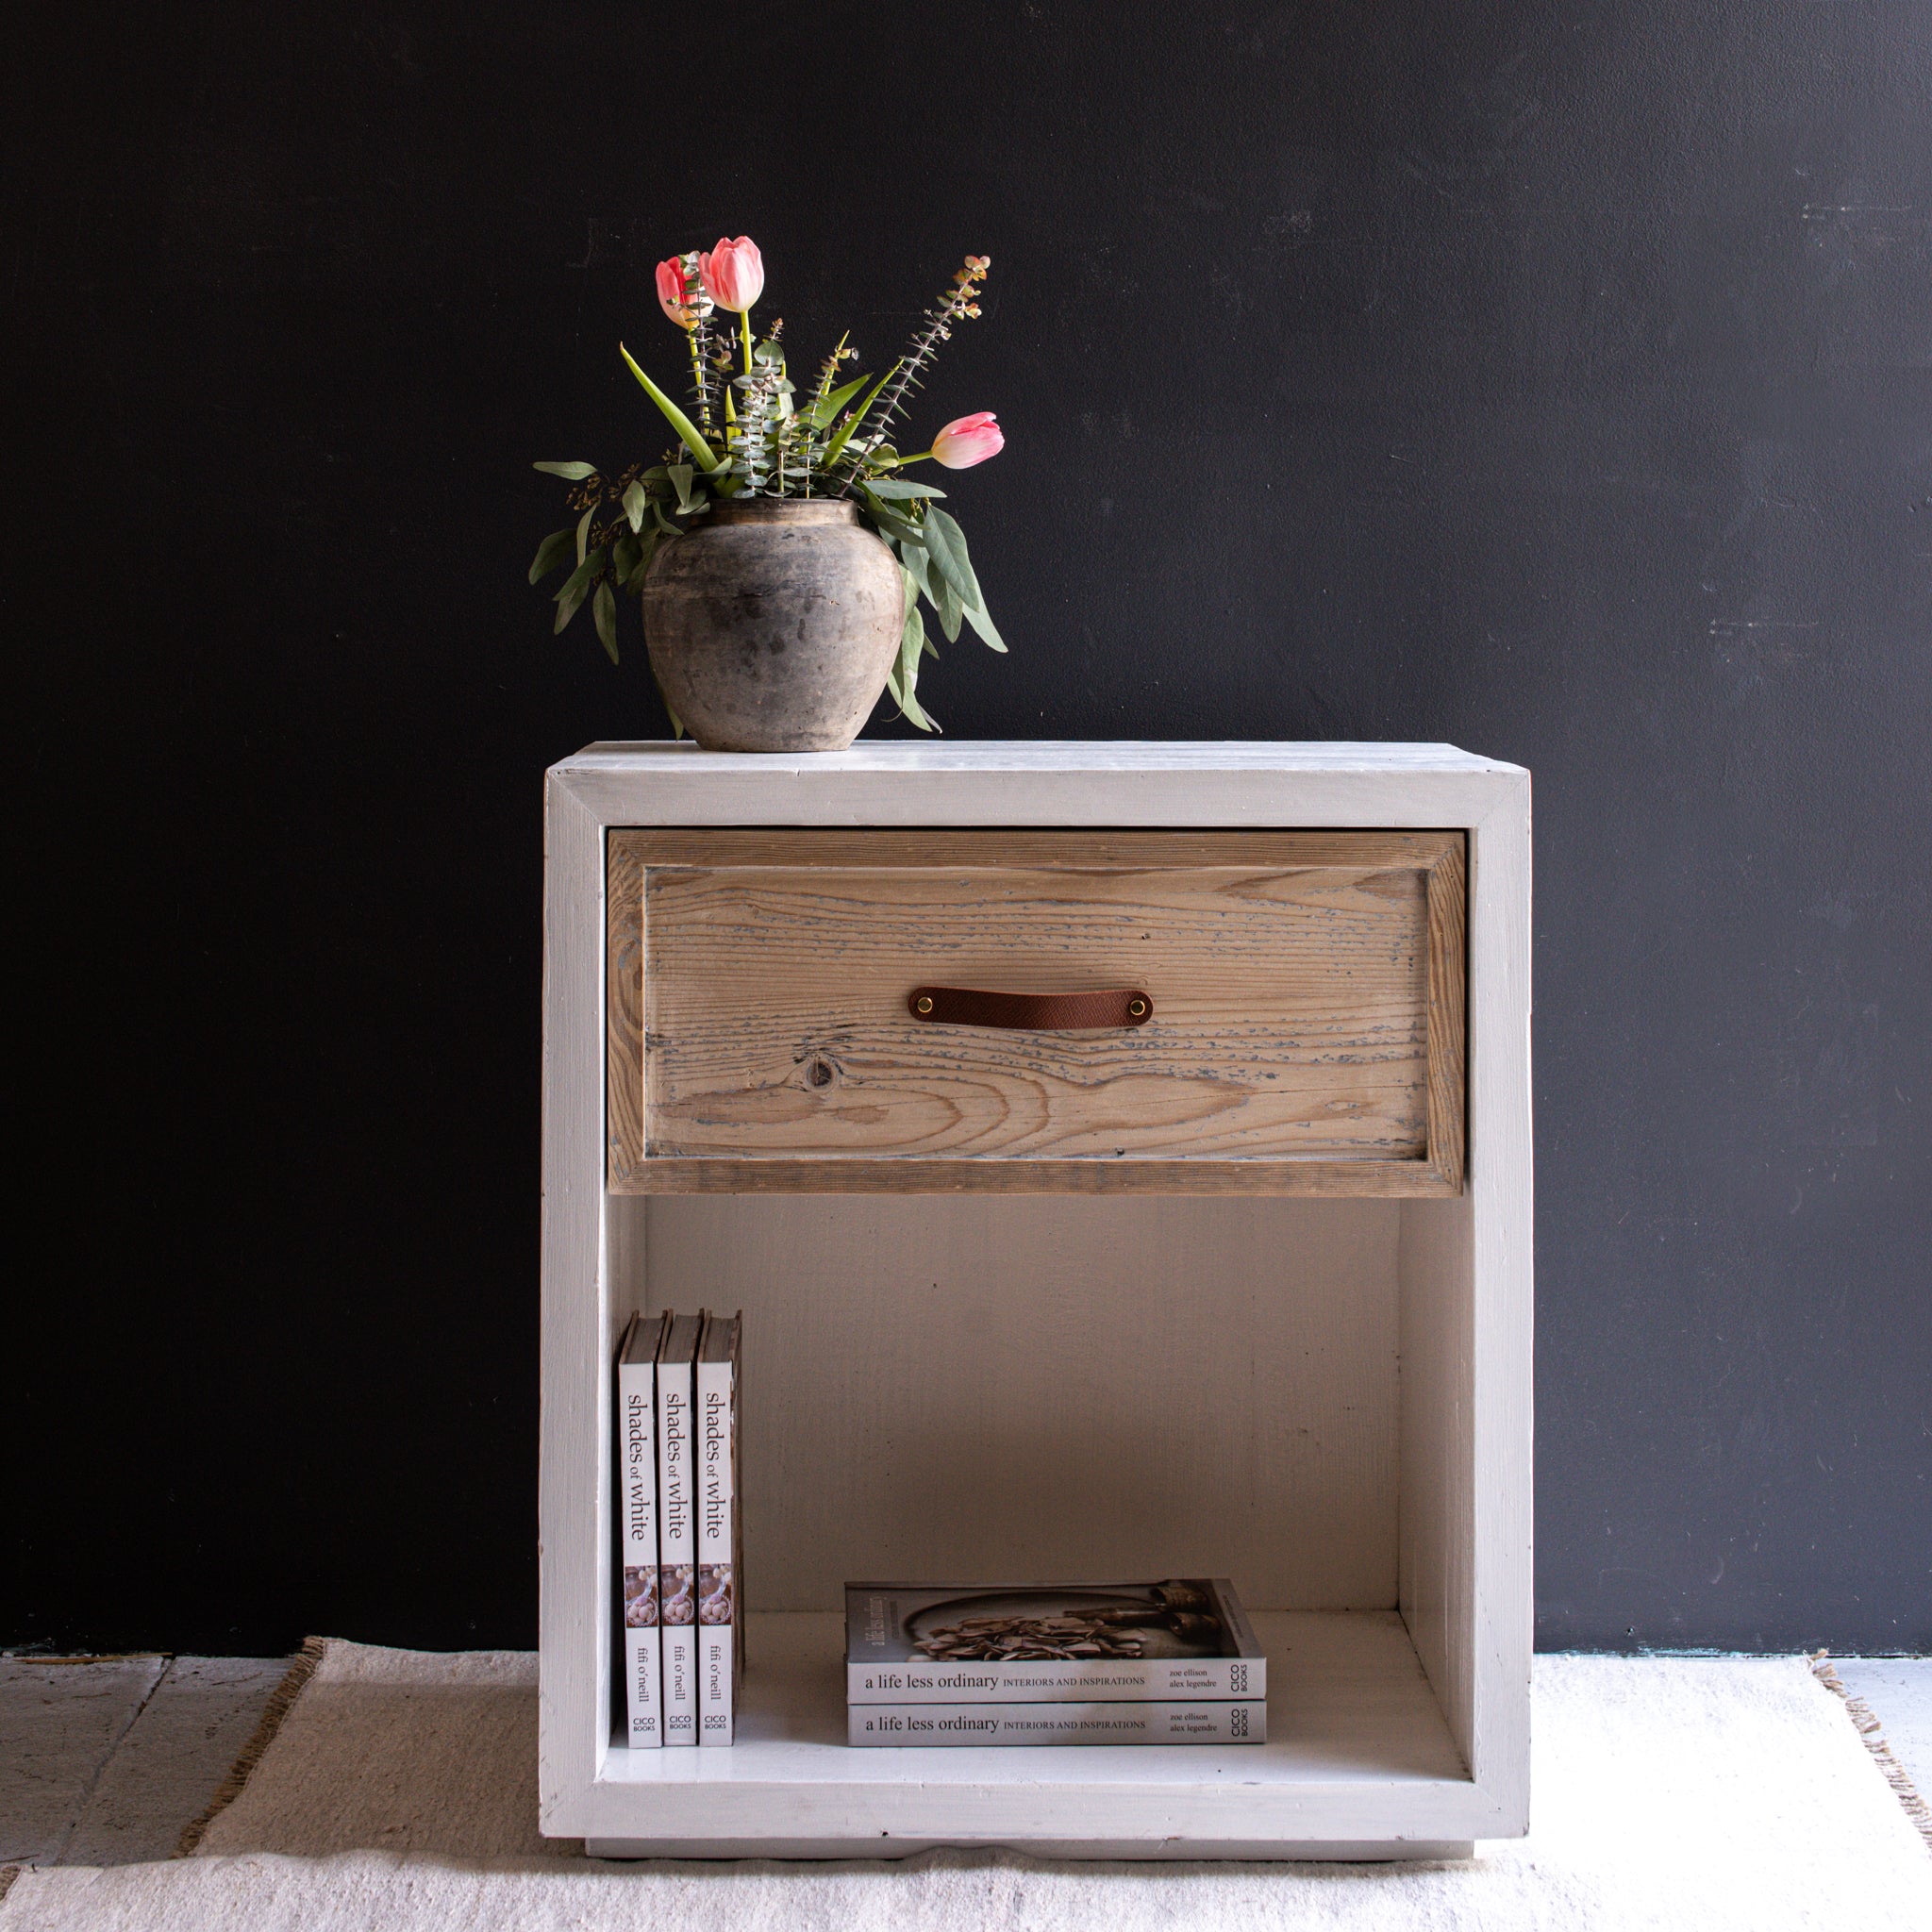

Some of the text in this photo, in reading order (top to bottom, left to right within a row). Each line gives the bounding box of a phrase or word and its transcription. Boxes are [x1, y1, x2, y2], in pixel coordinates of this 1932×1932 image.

[628, 1395, 650, 1541] shades of white
[667, 1393, 688, 1539] shades of white
[707, 1392, 726, 1539] shades of white
[638, 1647, 649, 1663] fifi
[674, 1645, 685, 1661] fifi
[710, 1645, 721, 1660] fifi
[1184, 1668, 1208, 1677] ellison
[1230, 1664, 1241, 1692] CICO
[865, 1674, 1146, 1691] a life less ordinary INTERIORS AND INSPIRATIONS
[1169, 1679, 1217, 1690] alex legendre
[633, 1717, 655, 1725] CICO
[669, 1715, 691, 1724] CICO
[705, 1715, 726, 1724] CICO
[865, 1715, 1146, 1734] a life less ordinary INTERIORS AND INSPIRATIONS
[1185, 1712, 1208, 1722] ellison
[1230, 1708, 1241, 1737] CICO
[1241, 1708, 1249, 1737] BOOKS
[1170, 1724, 1218, 1734] alex legendre
